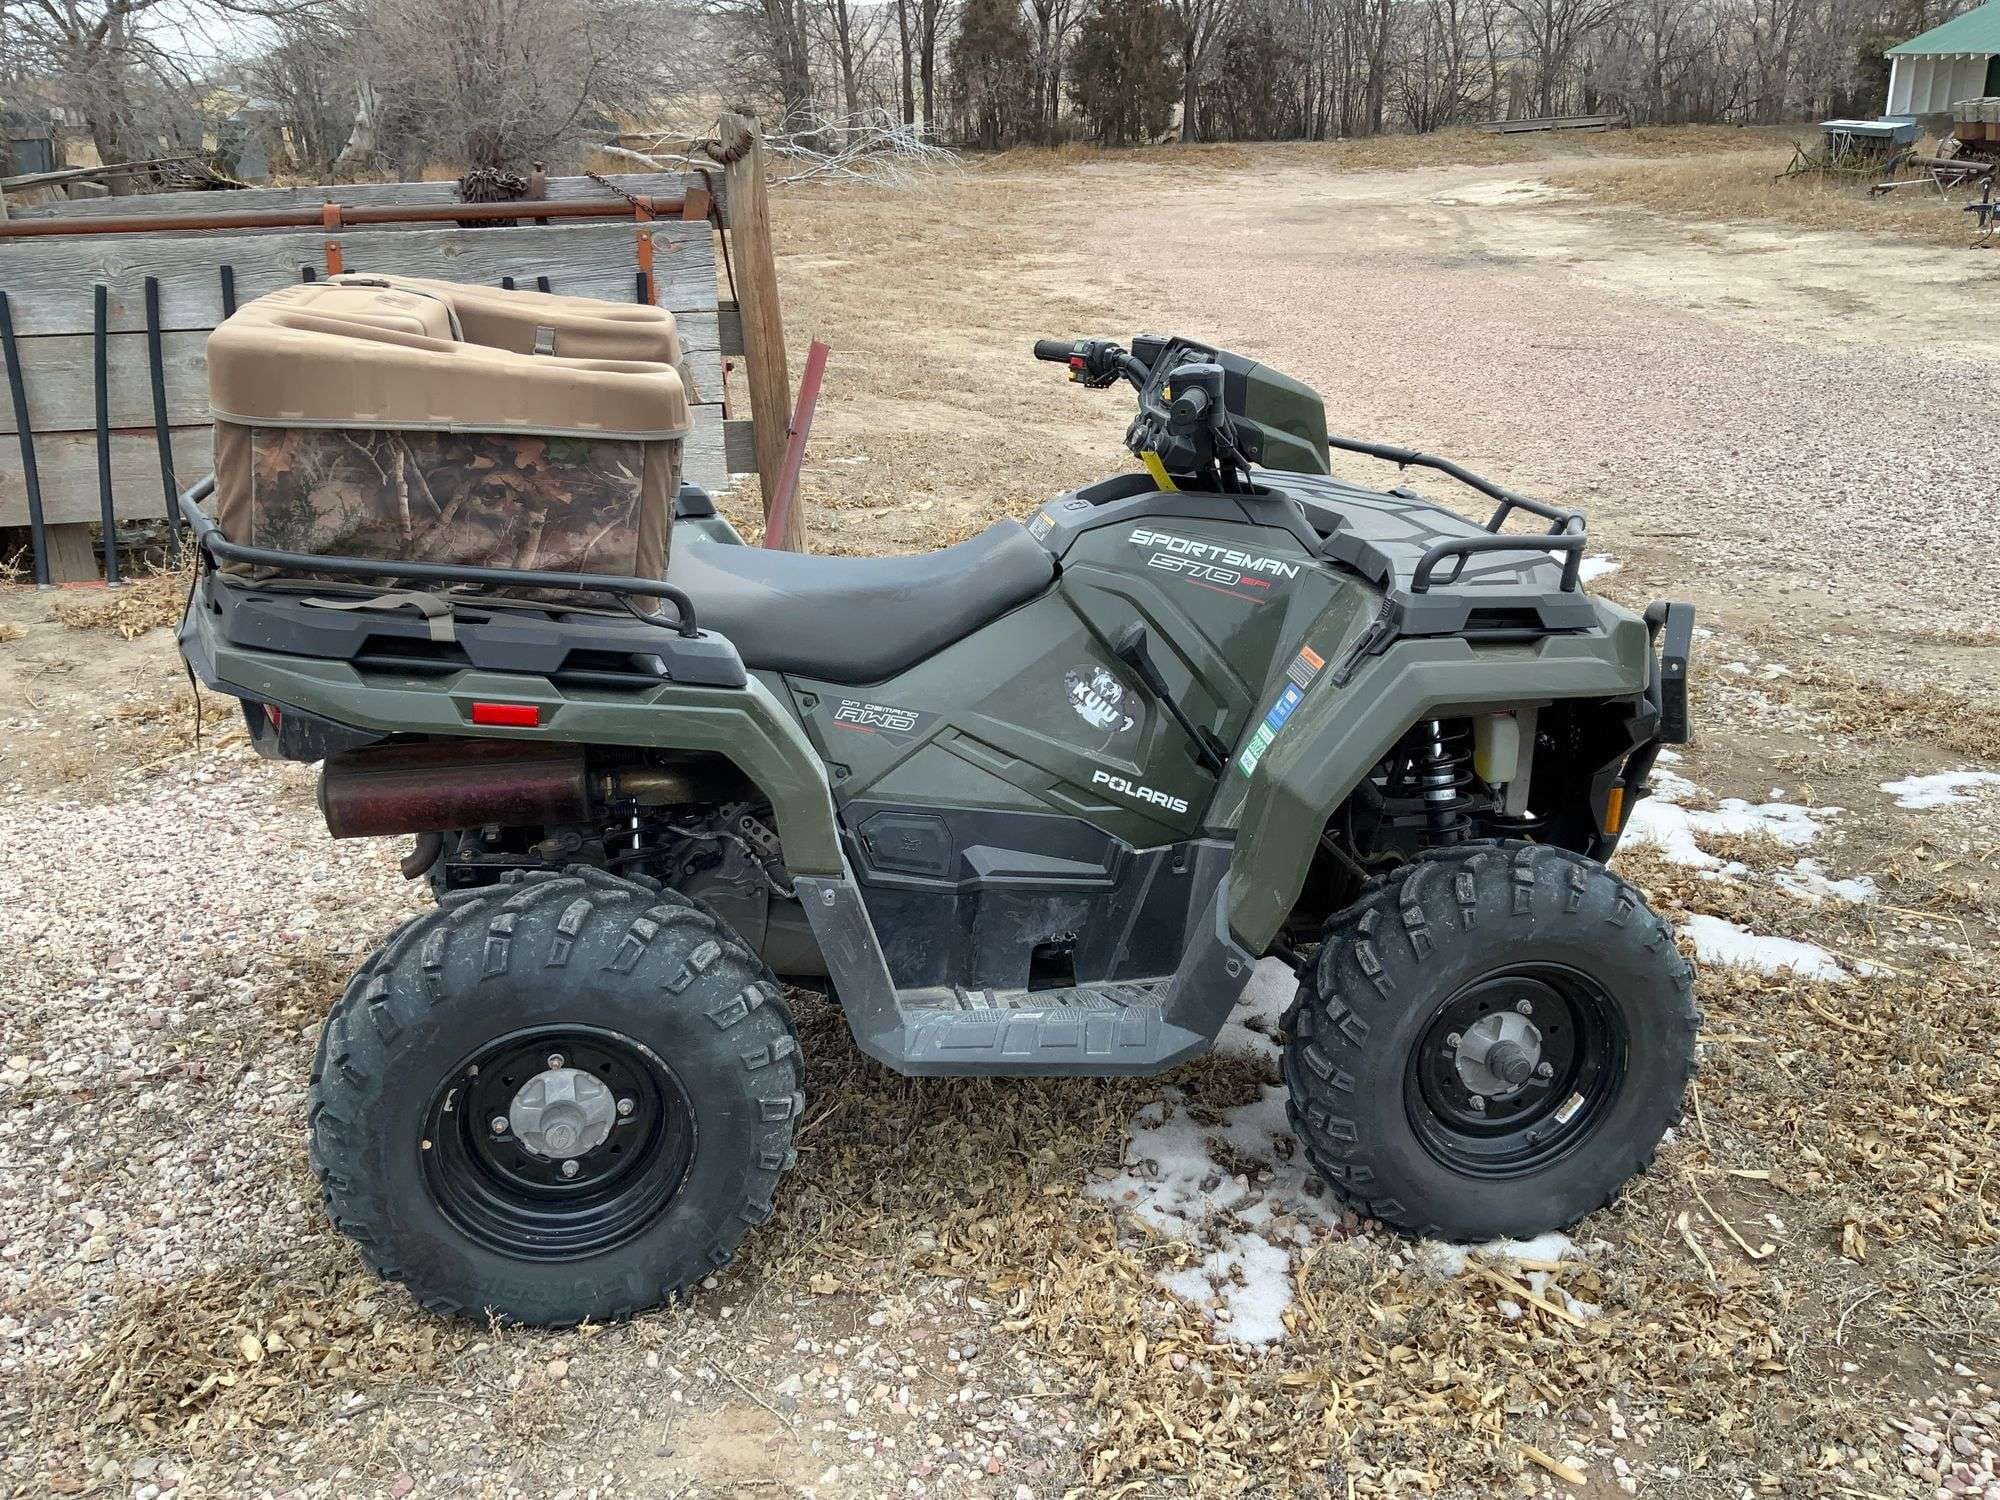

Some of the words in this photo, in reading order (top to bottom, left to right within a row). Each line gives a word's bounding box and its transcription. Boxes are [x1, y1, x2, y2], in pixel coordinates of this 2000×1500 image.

[1128, 529, 1300, 579] SPORTSMAN
[1148, 552, 1241, 586] 570
[834, 705, 916, 732] AWD
[1091, 770, 1189, 814] POLARIS
